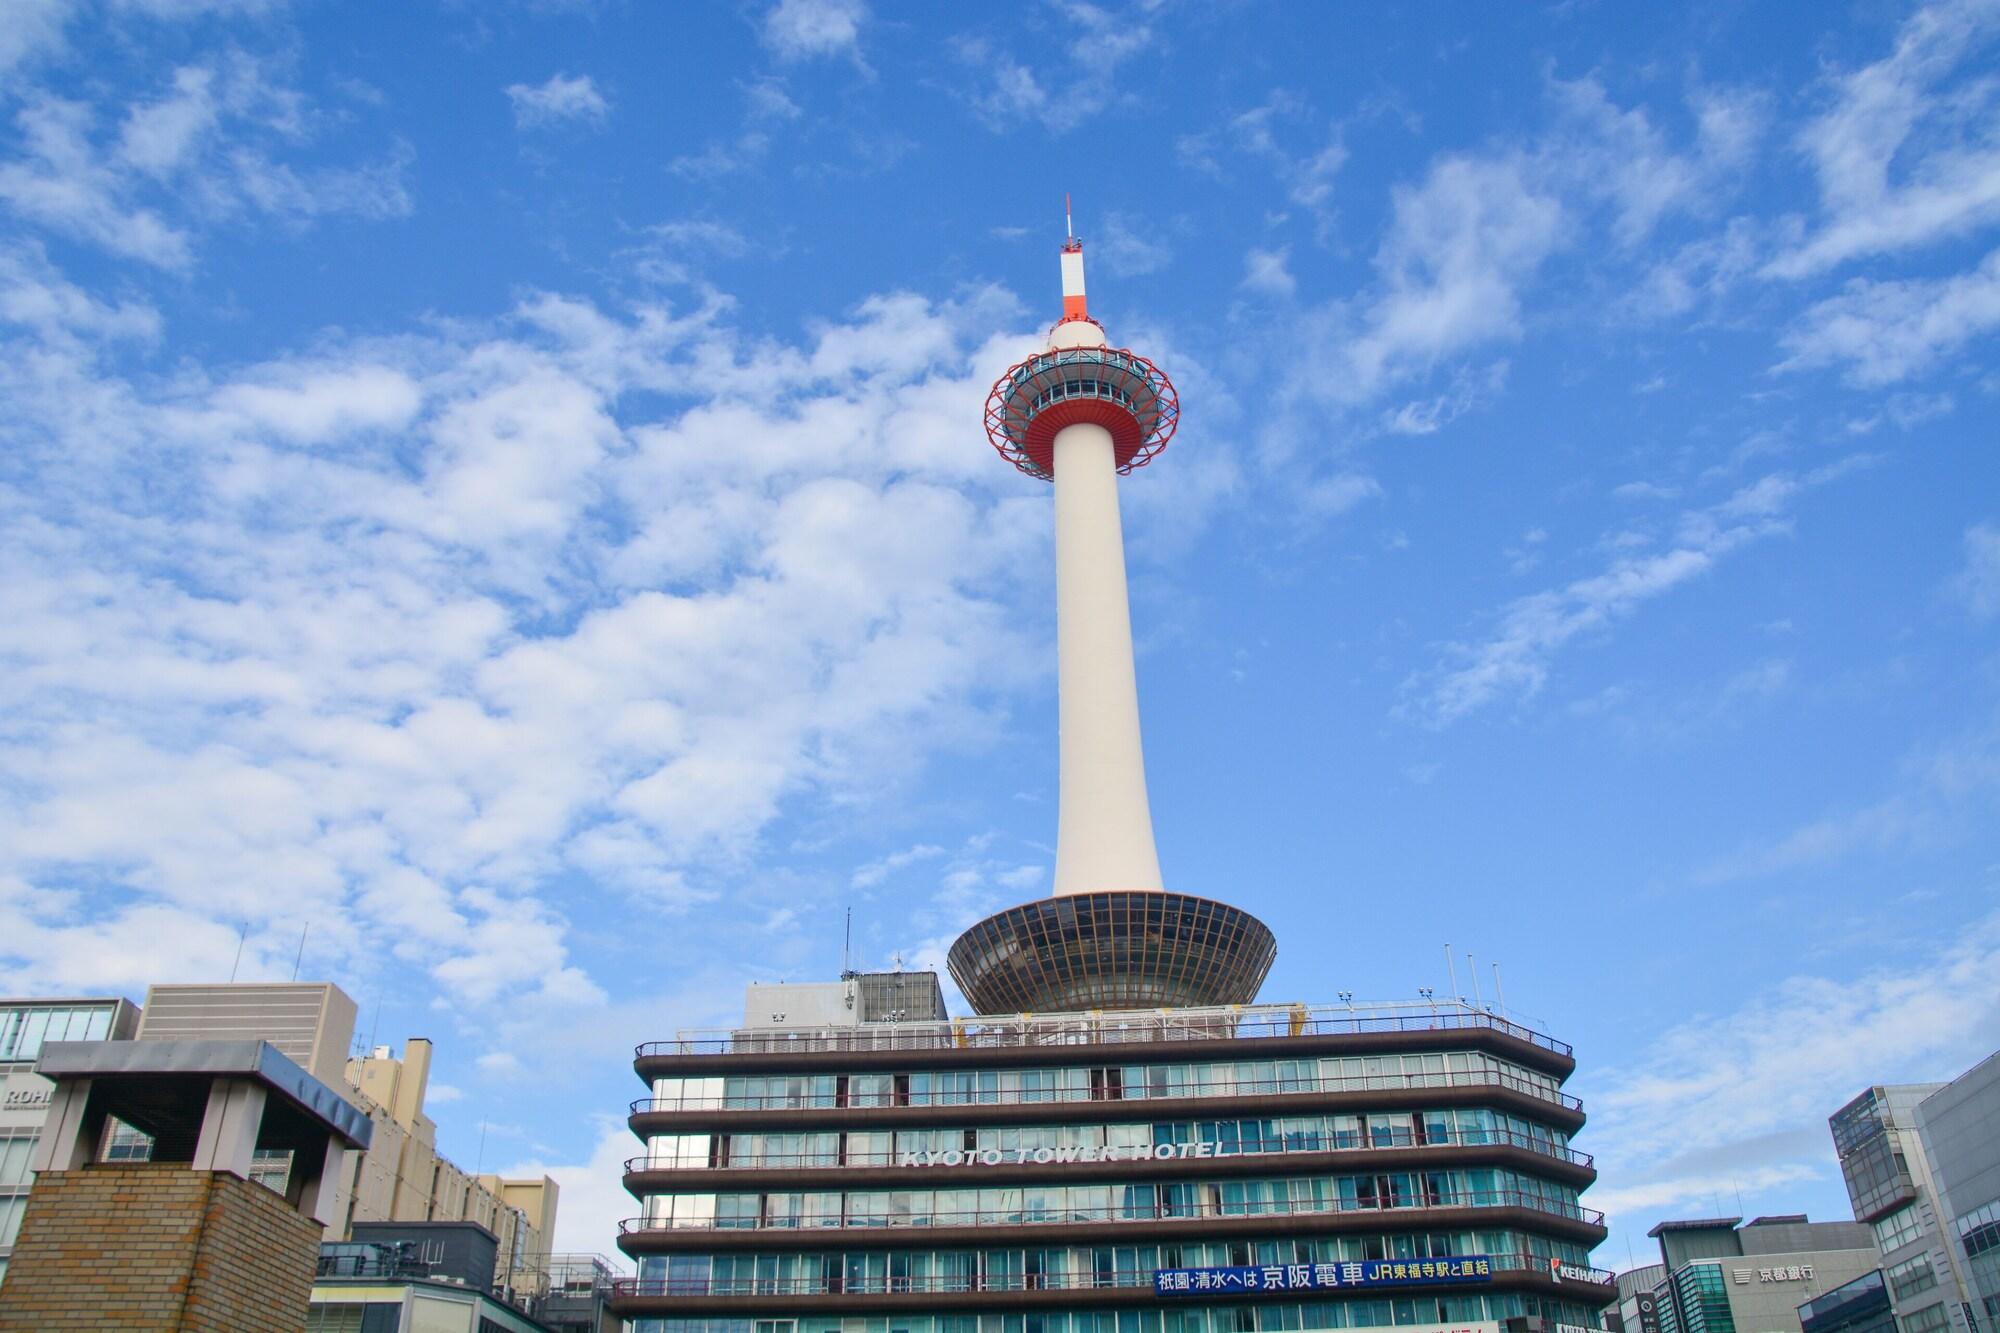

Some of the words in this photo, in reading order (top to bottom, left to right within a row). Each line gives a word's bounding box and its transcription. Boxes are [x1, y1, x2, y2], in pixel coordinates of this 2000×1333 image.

[5, 1090, 51, 1104] ROH
[901, 1149, 1002, 1167] KYOTO
[1015, 1146, 1118, 1164] TOWER
[1130, 1141, 1229, 1161] HOTEL
[1262, 1262, 1365, 1290] 京阪電車
[1369, 1259, 1490, 1281] JR東福寺駅と直結
[1560, 1265, 1604, 1285] KEIHAN
[1758, 1264, 1814, 1282] 京都銀行
